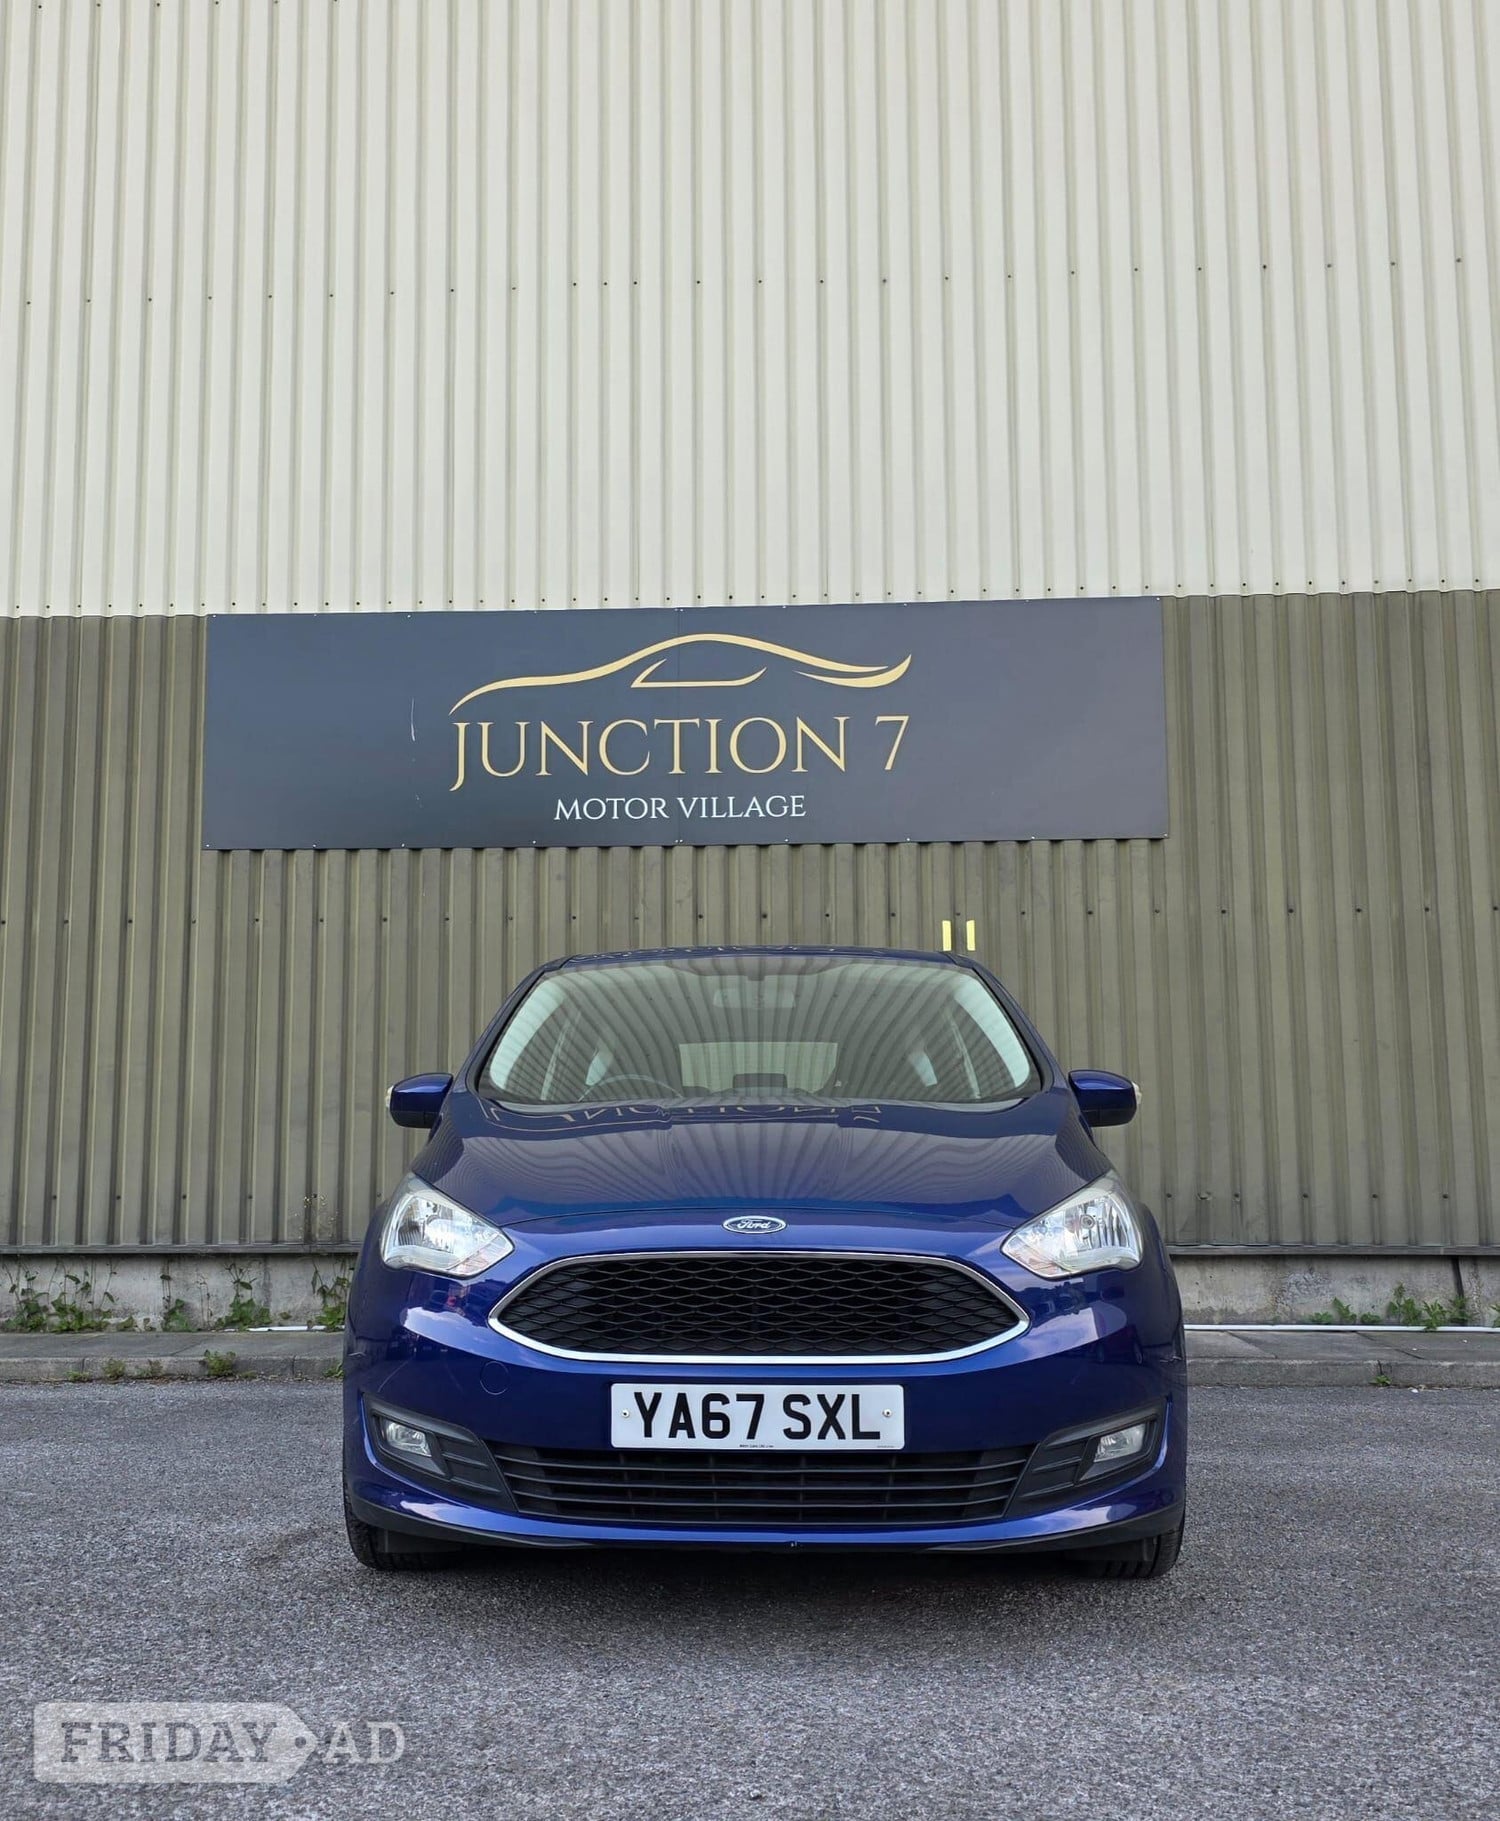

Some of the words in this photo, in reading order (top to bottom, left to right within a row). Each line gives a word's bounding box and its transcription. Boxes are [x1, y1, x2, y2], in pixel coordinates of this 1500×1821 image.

[449, 715, 850, 792] JUNCTION
[875, 715, 911, 771] 7
[554, 796, 670, 821] MOTOR
[677, 794, 807, 819] VILLAGE
[737, 1218, 771, 1229] Ford
[633, 1391, 766, 1440] YA67
[782, 1393, 881, 1440] SXL
